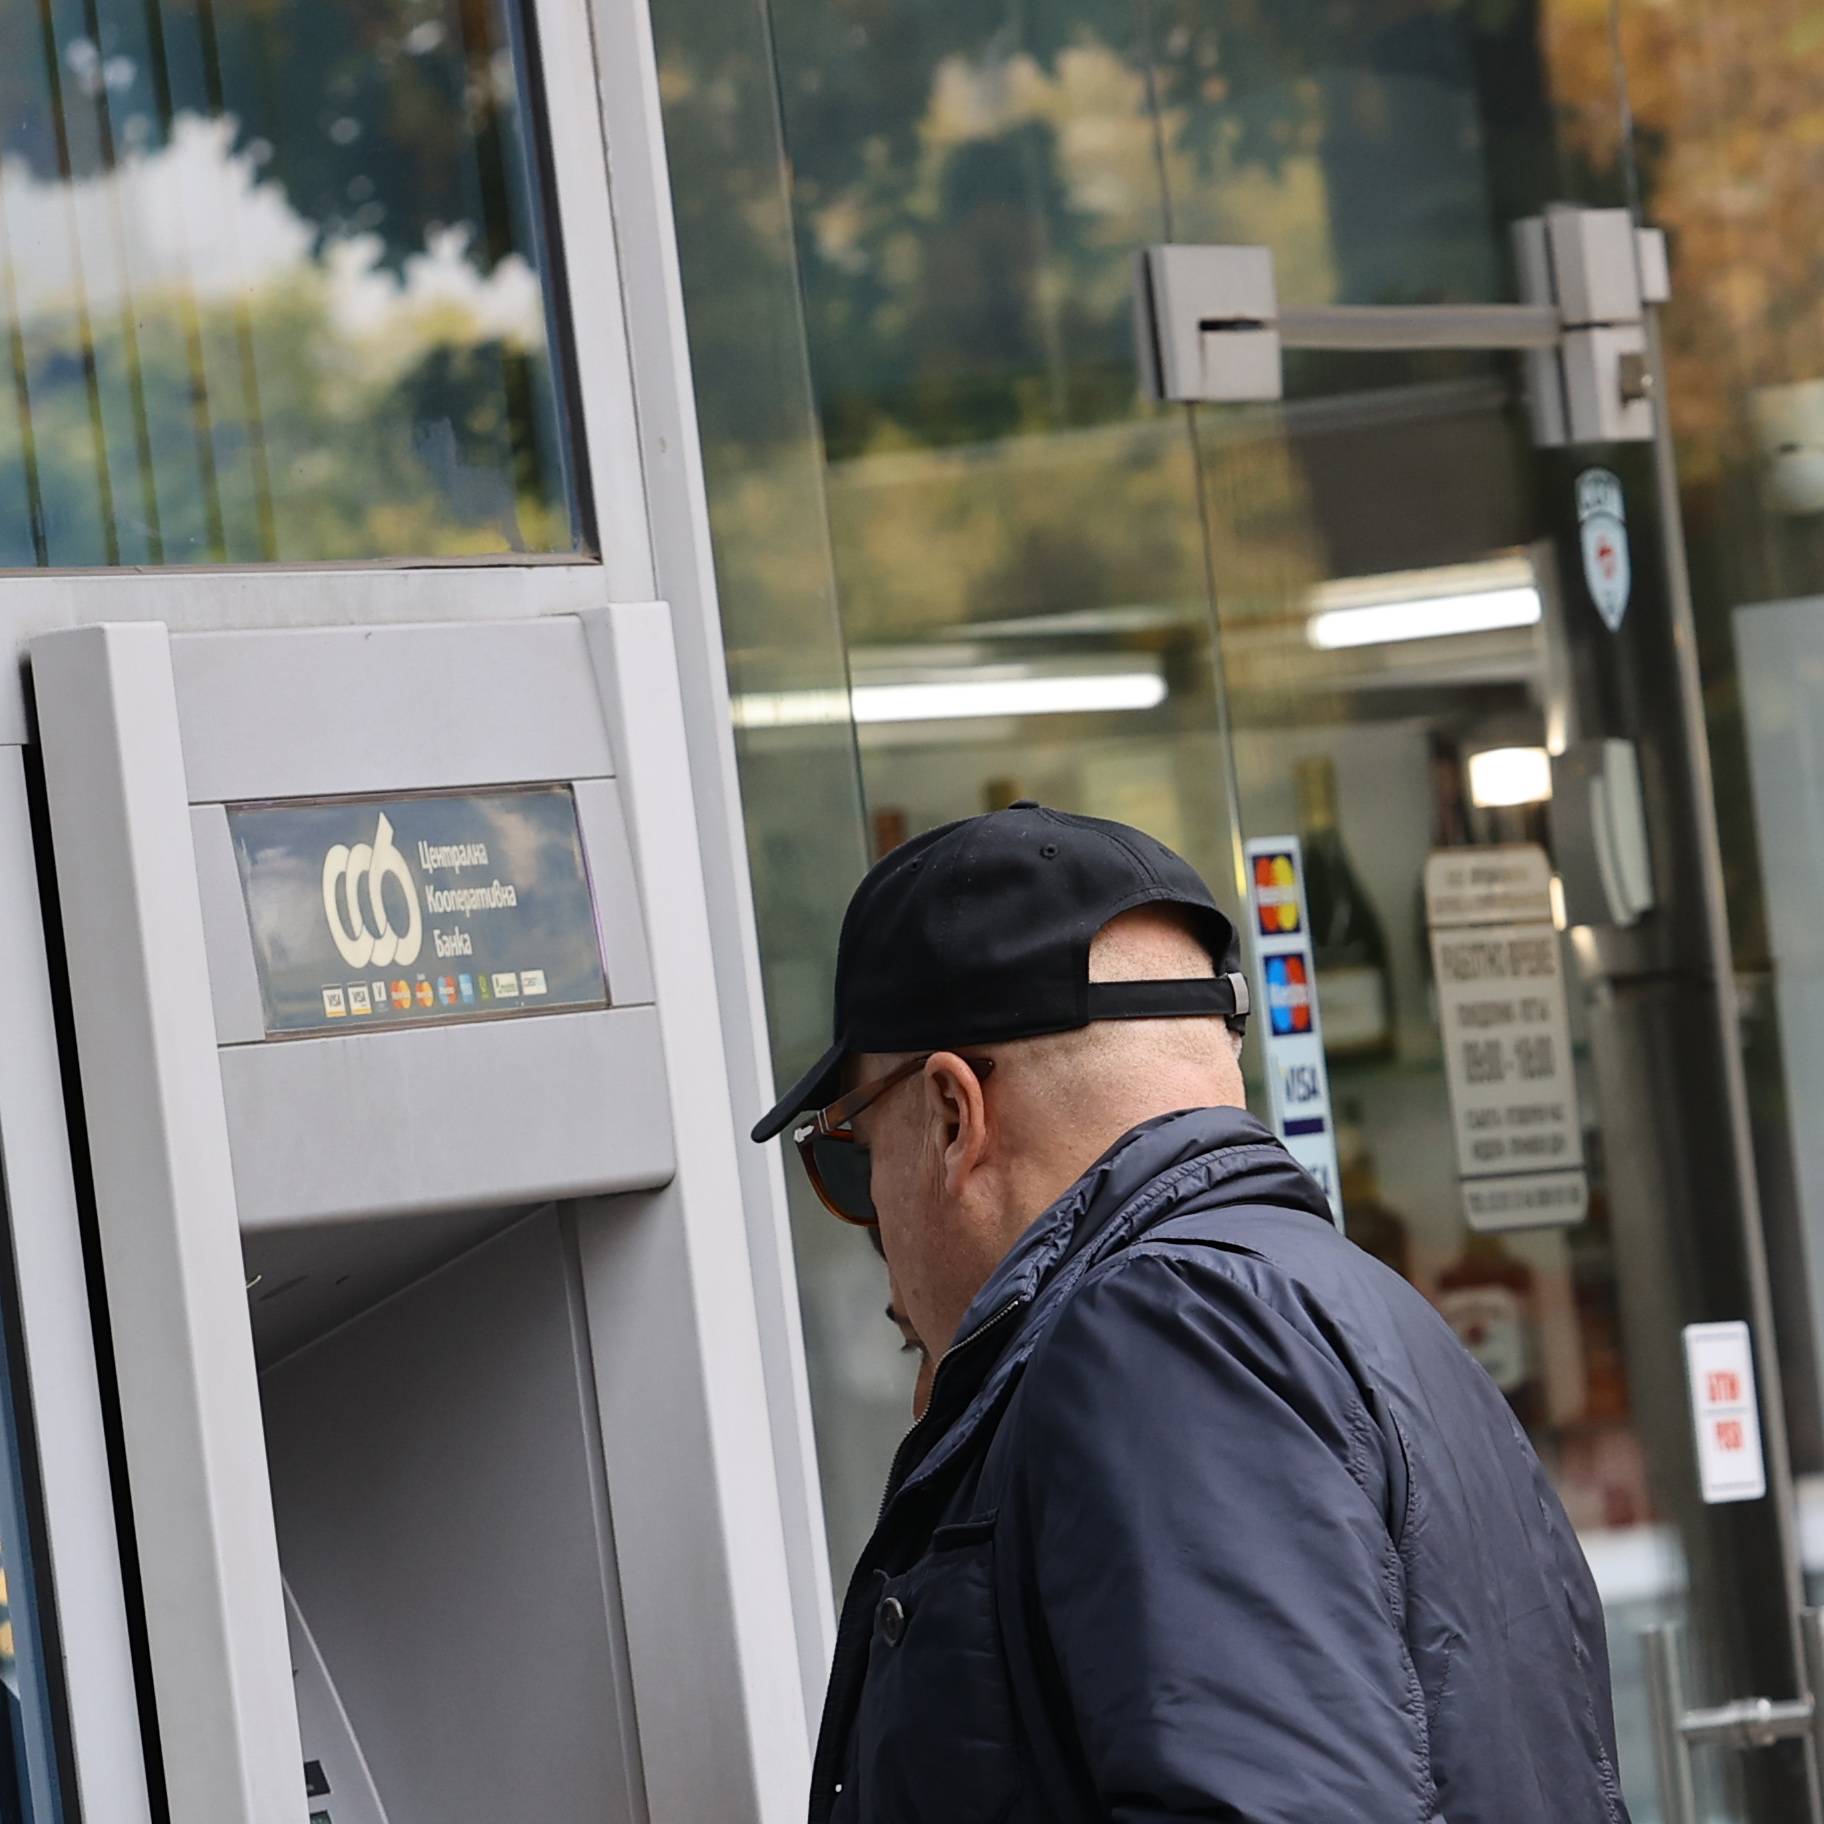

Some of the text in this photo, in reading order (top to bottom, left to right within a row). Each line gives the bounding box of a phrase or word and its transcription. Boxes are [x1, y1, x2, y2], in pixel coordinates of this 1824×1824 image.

[418, 840, 489, 874] Централна
[425, 879, 517, 918] Кооперативна
[433, 925, 473, 958] Банка
[1285, 1065, 1321, 1103] VISA
